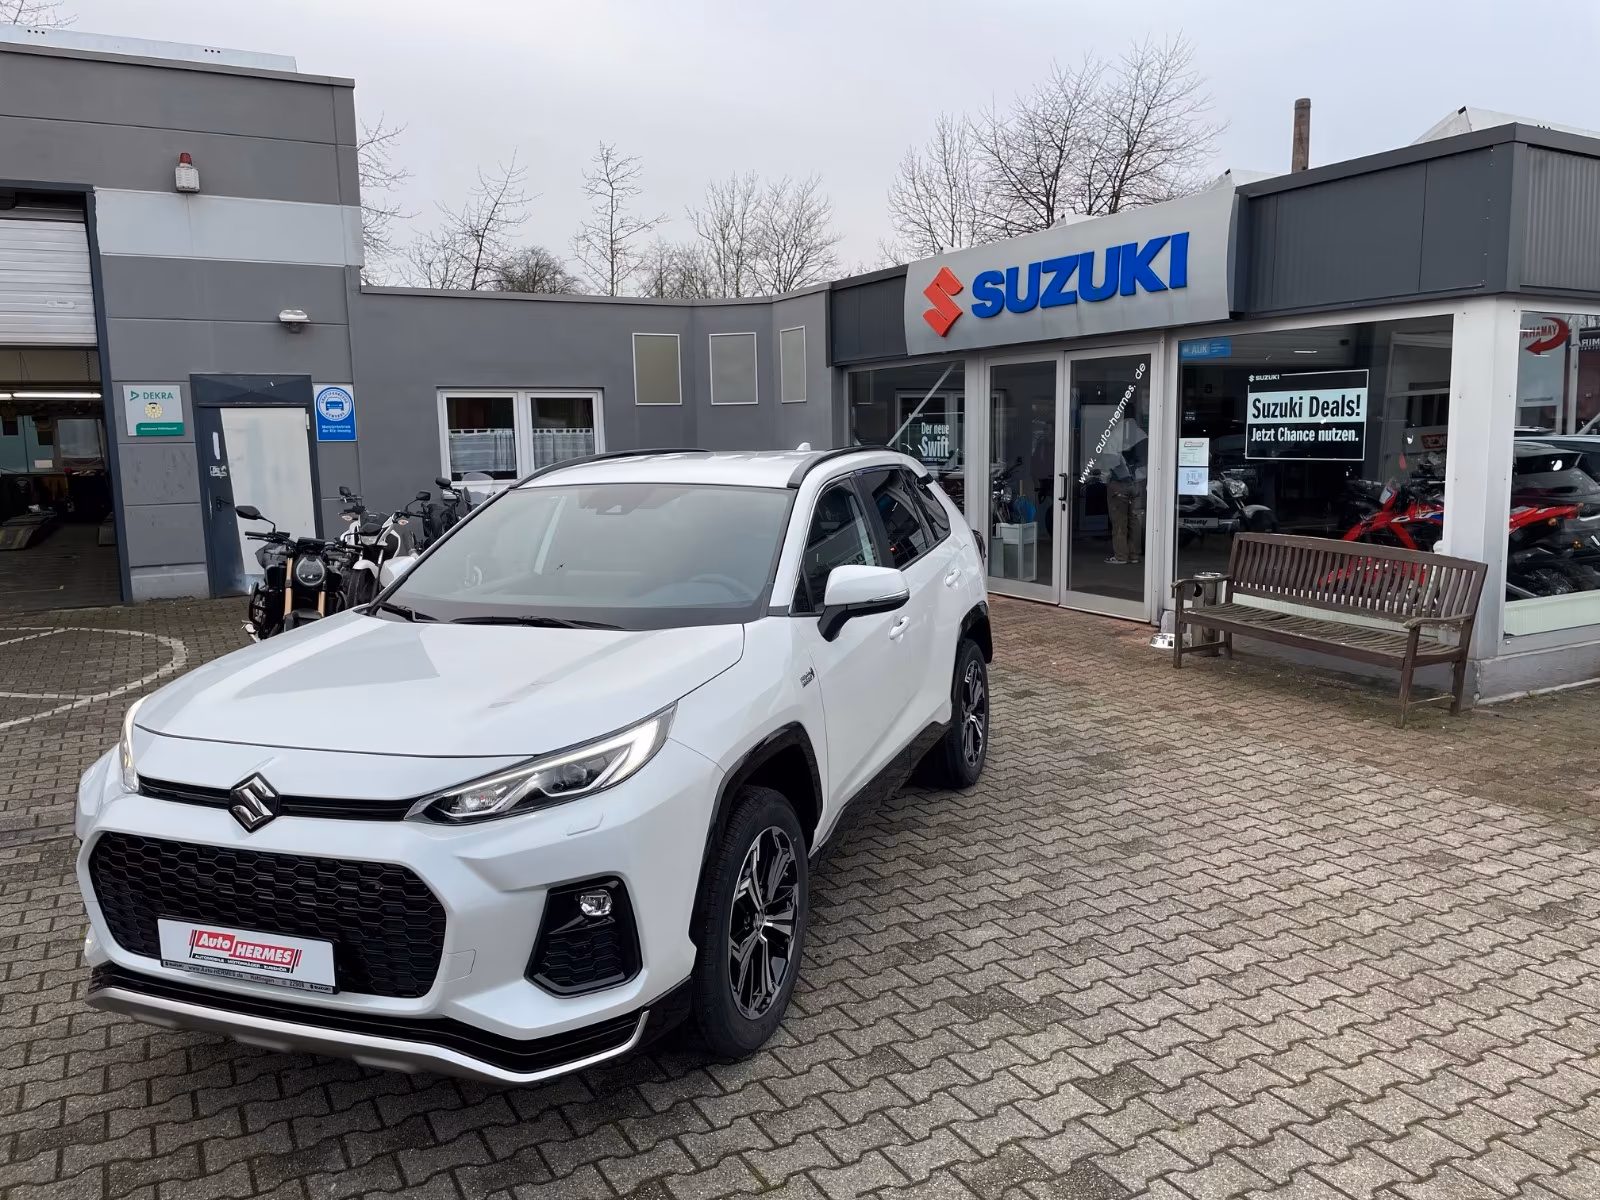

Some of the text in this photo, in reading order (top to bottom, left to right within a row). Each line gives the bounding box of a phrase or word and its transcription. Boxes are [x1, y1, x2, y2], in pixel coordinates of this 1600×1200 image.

[971, 231, 1189, 319] SUZUKI
[143, 391, 174, 400] DEKRA
[1252, 394, 1361, 419] Suzuki Deals!
[921, 422, 950, 435] Der neue
[1079, 457, 1097, 484] www.
[1135, 362, 1146, 380] de
[1251, 427, 1359, 442] Jetzt Chance nutzen.
[921, 436, 950, 457] Swift
[199, 933, 231, 949] Auto
[235, 943, 292, 963] HERMES
